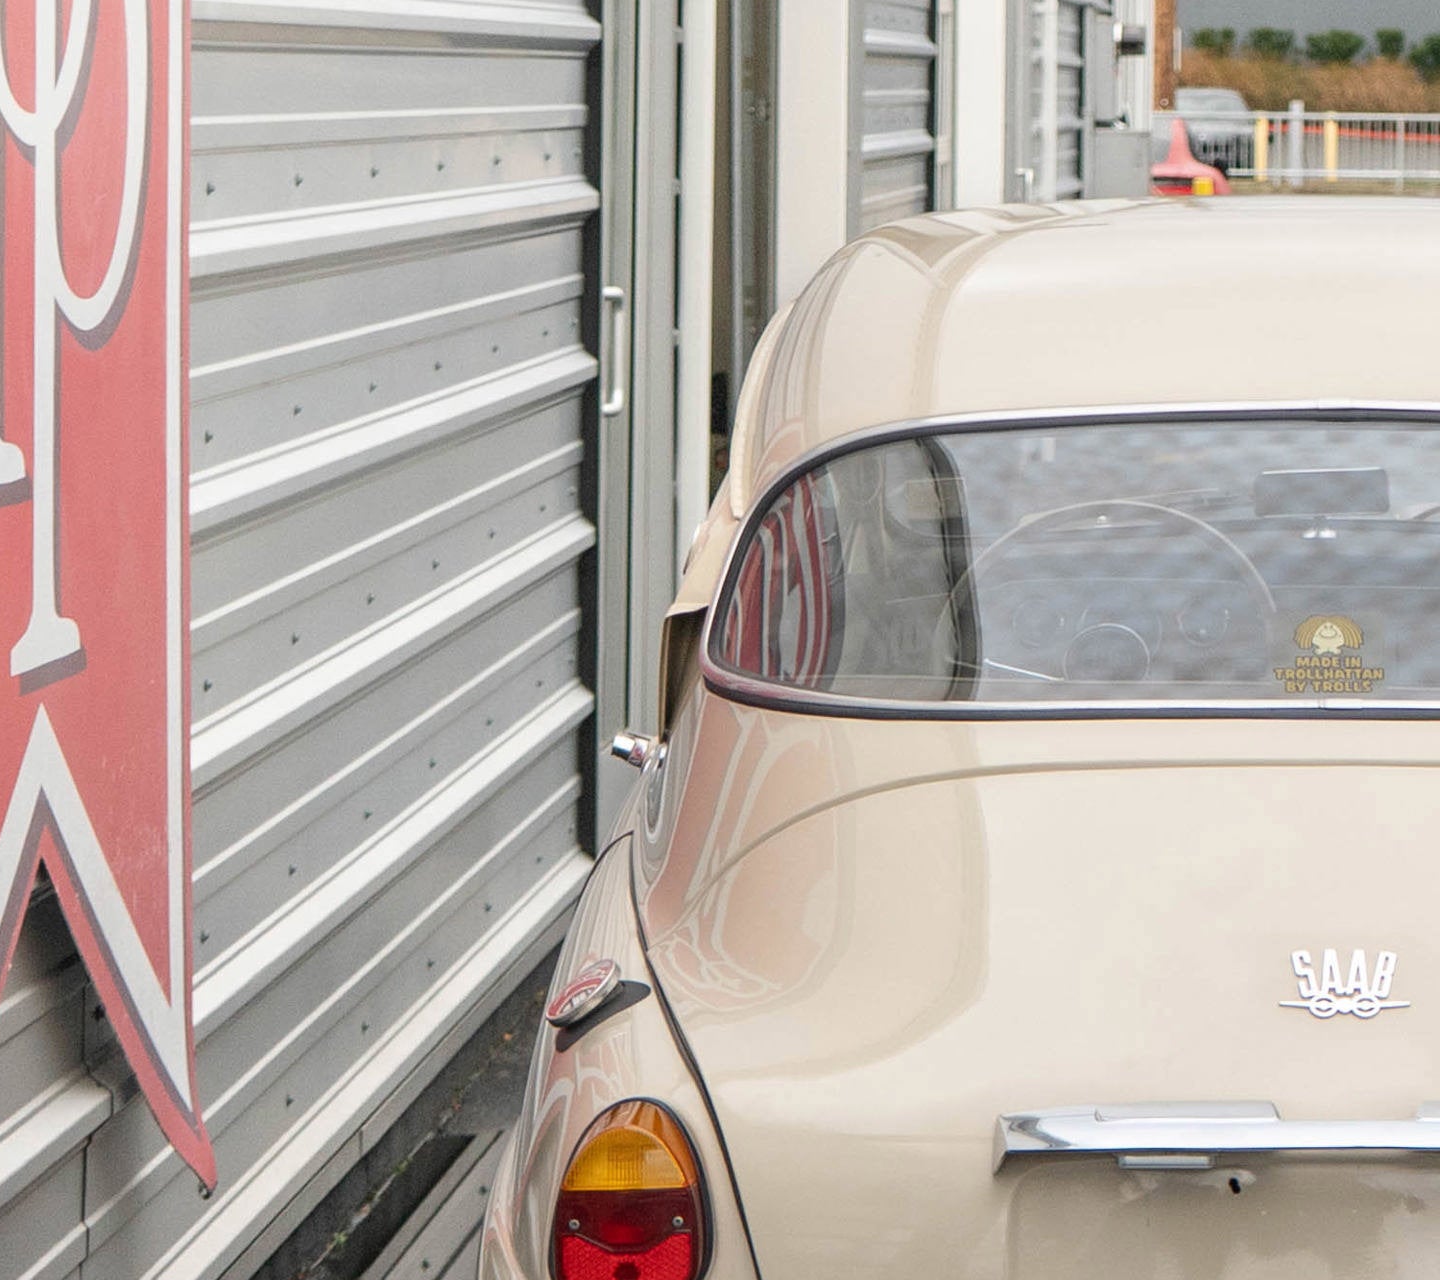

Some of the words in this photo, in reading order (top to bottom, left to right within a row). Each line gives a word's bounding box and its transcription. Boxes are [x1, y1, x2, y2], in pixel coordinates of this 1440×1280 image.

[1295, 656, 1340, 668] MADE
[1345, 656, 1362, 668] IN
[1285, 680, 1307, 693] BY
[1312, 680, 1373, 693] TROLLS
[1291, 948, 1398, 999] SAAB
